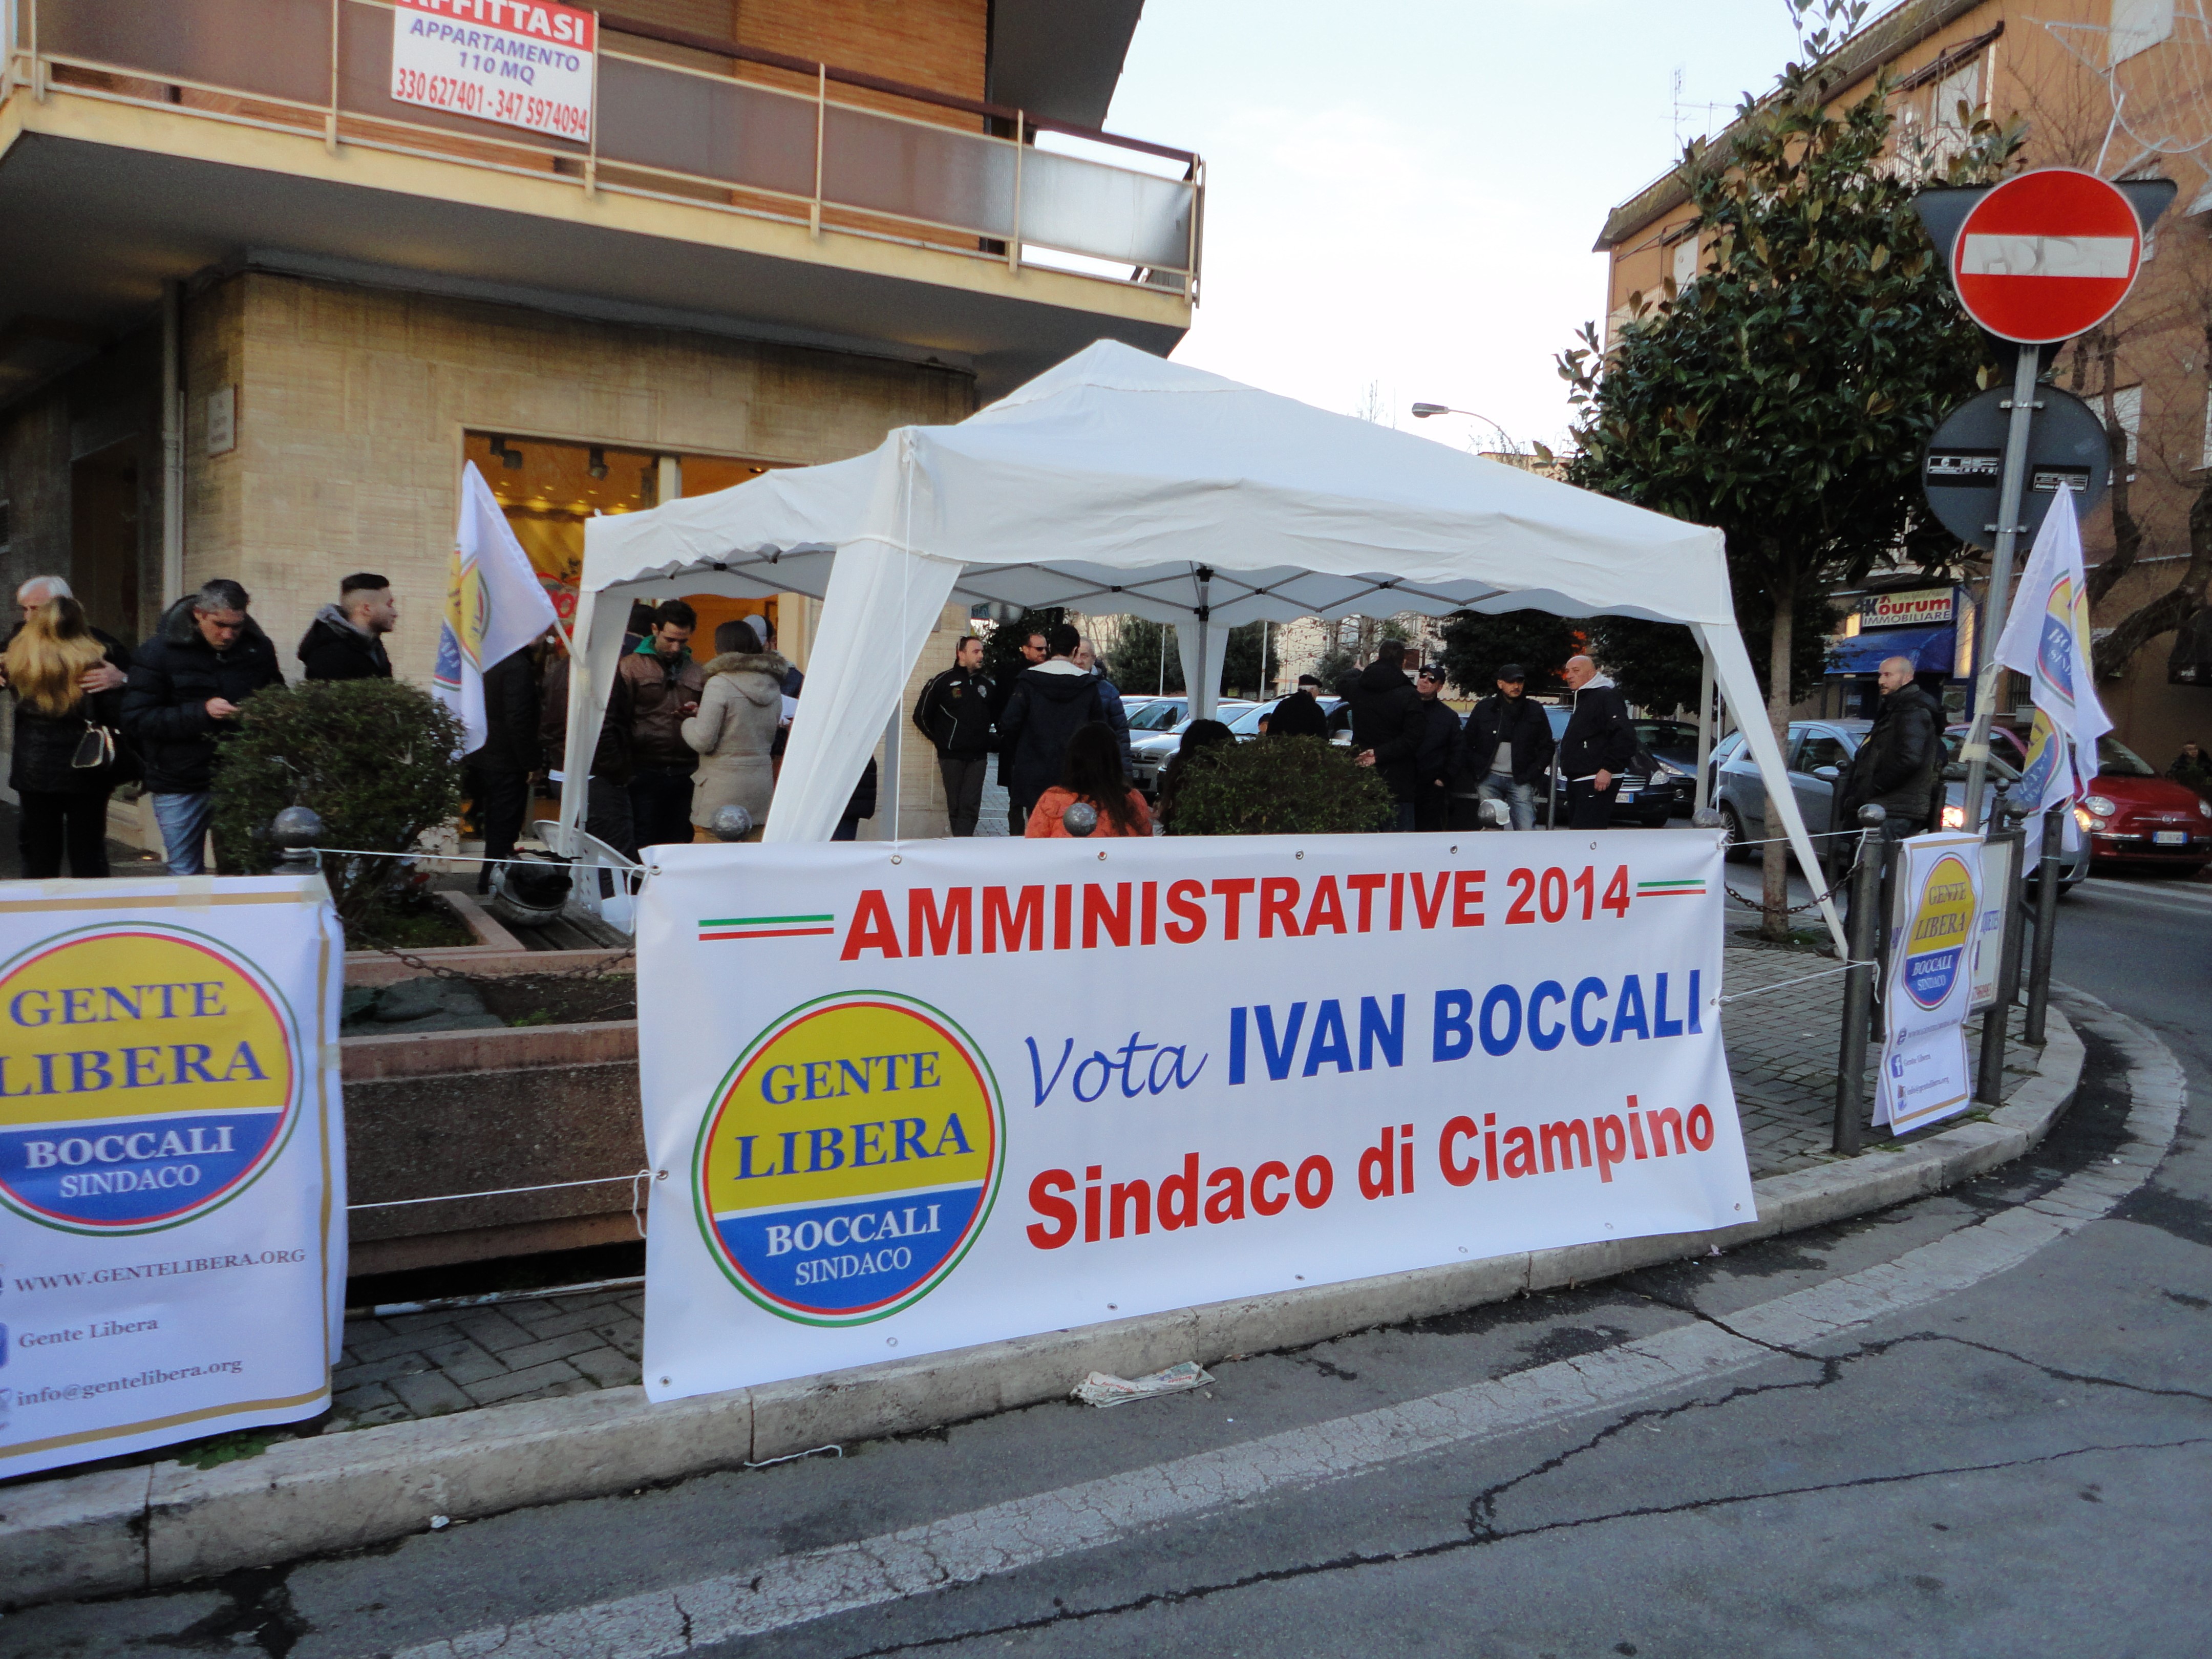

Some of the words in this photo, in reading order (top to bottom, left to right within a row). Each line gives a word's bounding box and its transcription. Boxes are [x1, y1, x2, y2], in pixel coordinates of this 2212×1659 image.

[410, 18, 580, 72] APPARTAMENTO
[460, 51, 495, 74] 110
[500, 60, 536, 86] MQ
[396, 68, 426, 101] 330
[525, 99, 587, 136] 5974094
[1864, 611, 1950, 625] IMMOBILIARE
[840, 870, 1485, 961] AMMINISTRATIVE
[1505, 865, 1630, 924] 2014
[1928, 882, 1966, 905] GENTE
[1915, 912, 1965, 941] LIBERA
[1911, 954, 1953, 976] BOCCALI
[9, 981, 227, 1027] GENTE
[1025, 1032, 1208, 1108] Vota
[1228, 993, 1405, 1085] IVAN
[1433, 969, 1702, 1062] BOCCALI
[0, 1041, 271, 1097] LIBERA
[761, 1051, 942, 1105] GENTE
[24, 1126, 235, 1169] BOCCALI
[734, 1112, 975, 1180] LIBERA
[60, 1164, 201, 1198] SINDACO
[1026, 1152, 1333, 1250] Sindaco
[1358, 1124, 1414, 1200] di
[1439, 1095, 1713, 1186] Ciampino
[765, 1204, 942, 1257] BOCCALI
[14, 1248, 306, 1292] WWW.GENTELIBERA.ORG
[795, 1246, 912, 1286] SINDACO
[19, 1330, 84, 1349] Gente
[89, 1318, 159, 1339] Libera
[17, 1359, 243, 1407] info@gentelibera.org
